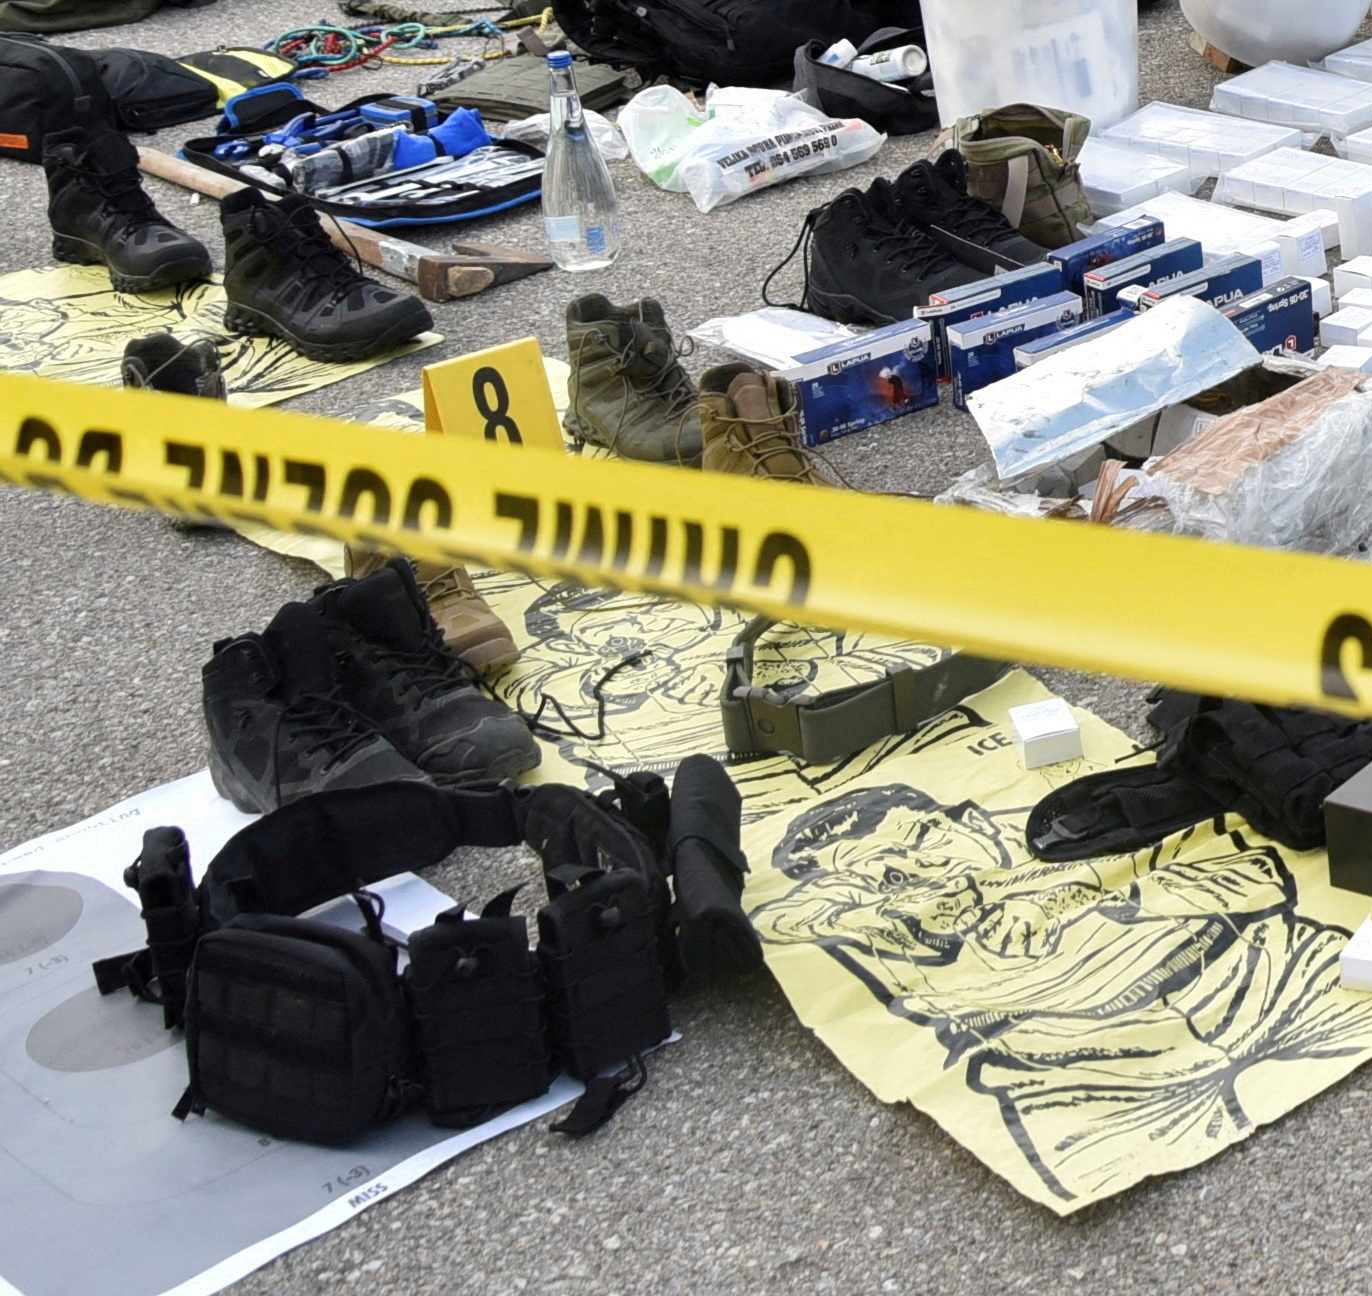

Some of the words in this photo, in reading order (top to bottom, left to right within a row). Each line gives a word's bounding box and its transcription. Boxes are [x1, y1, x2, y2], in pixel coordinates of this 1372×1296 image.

[717, 149, 751, 170] VELIKA
[1205, 288, 1245, 308] APUA
[995, 324, 1026, 339] LAPUA
[841, 352, 872, 370] LAPUA
[472, 366, 524, 448] 8
[346, 1182, 389, 1209] MISS
